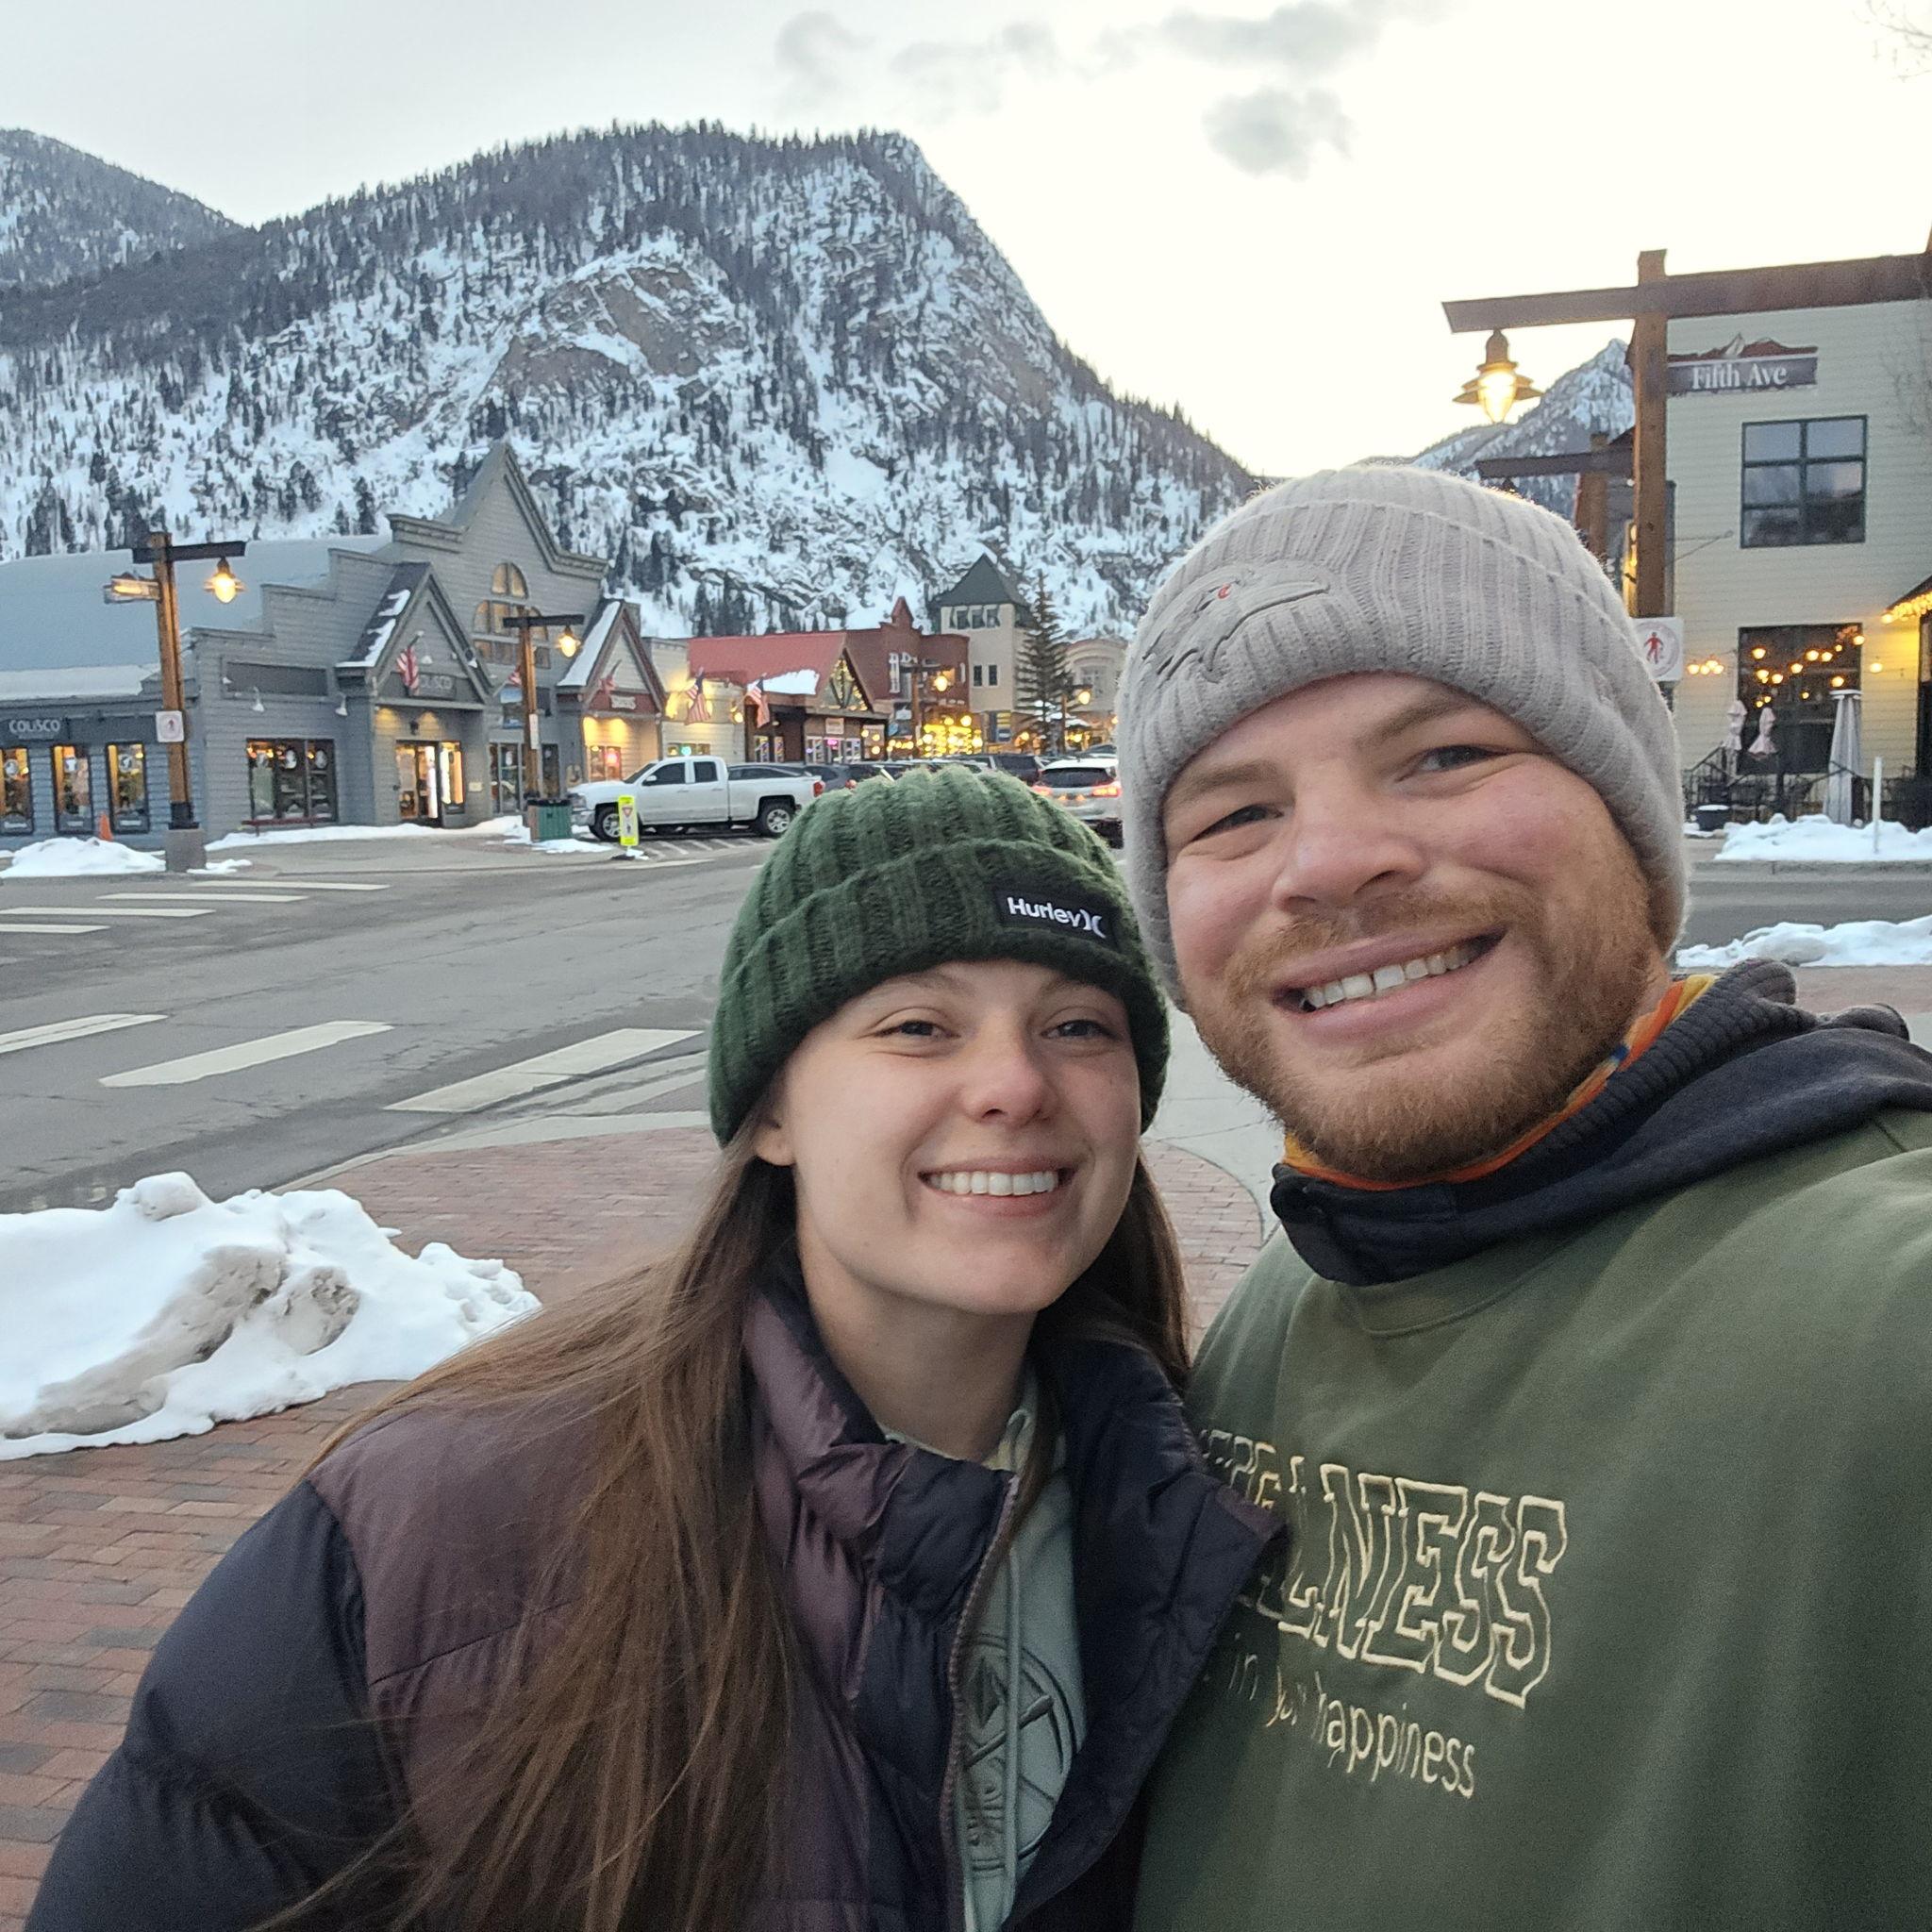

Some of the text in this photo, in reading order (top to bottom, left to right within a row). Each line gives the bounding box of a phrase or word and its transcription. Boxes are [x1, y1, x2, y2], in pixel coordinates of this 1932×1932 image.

[1692, 362, 1788, 390] Fifth Ave
[1007, 896, 1081, 928] Hurley
[1310, 1671, 1476, 1800] happiness
